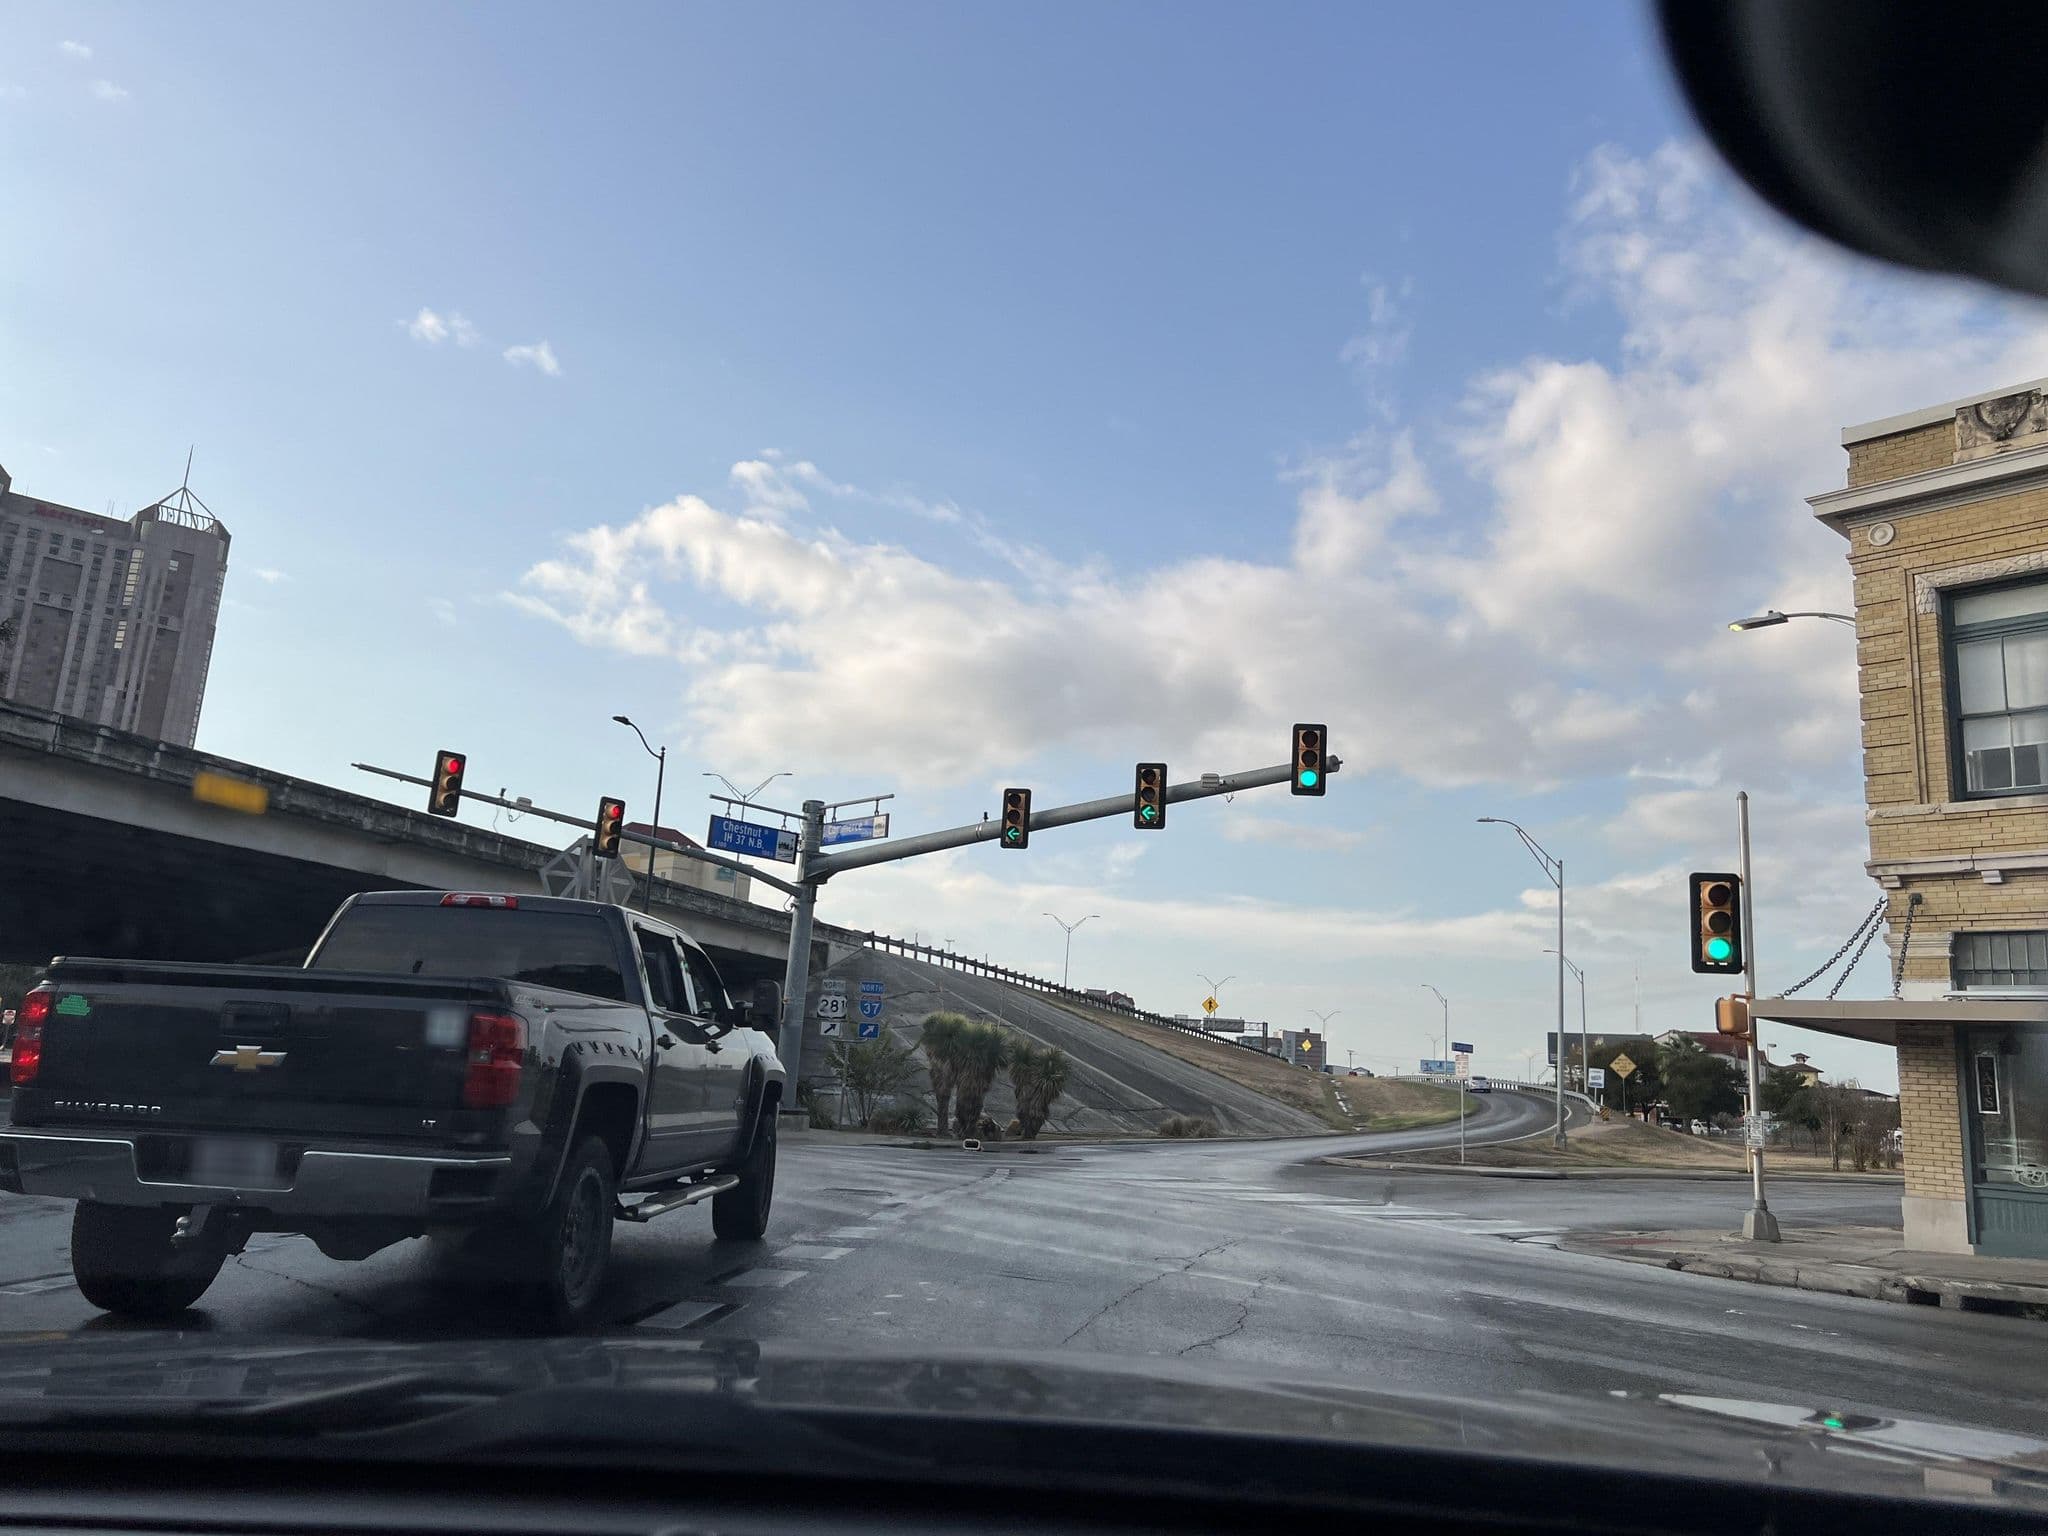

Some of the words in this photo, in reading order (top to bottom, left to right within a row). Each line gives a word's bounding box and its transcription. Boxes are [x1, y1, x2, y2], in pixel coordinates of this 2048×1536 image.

[722, 820, 762, 837] Chestnut
[723, 832, 733, 843] IH
[735, 834, 746, 846] 37
[748, 838, 765, 850] N.B.
[862, 983, 883, 992] NORTH
[863, 1003, 880, 1015] 37
